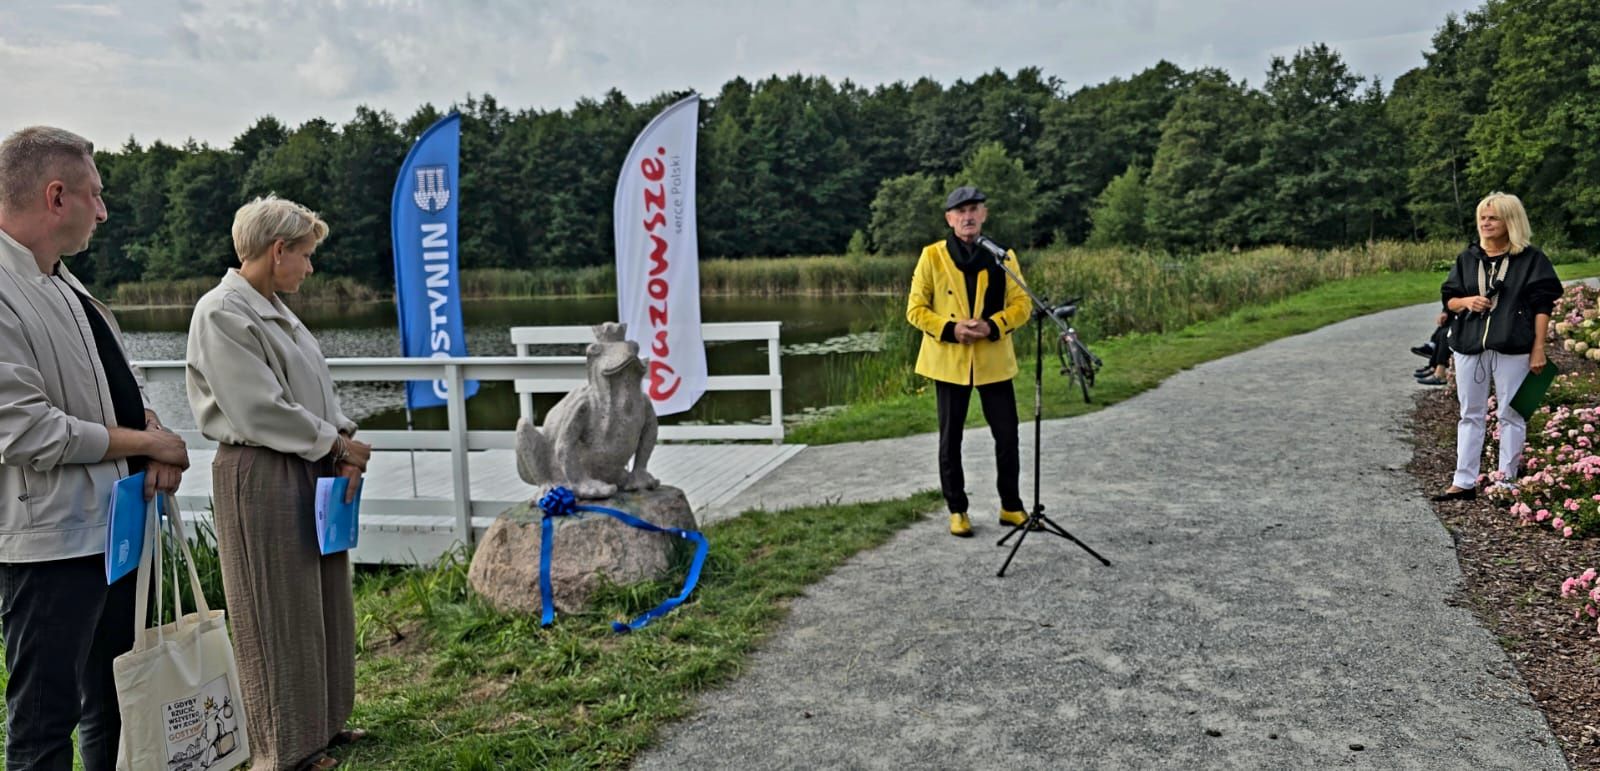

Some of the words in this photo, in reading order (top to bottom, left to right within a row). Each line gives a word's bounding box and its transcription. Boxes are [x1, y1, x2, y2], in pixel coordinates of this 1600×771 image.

[670, 155, 682, 195] Polski
[673, 199, 684, 235] serce
[420, 222, 451, 400] GSTYNIN
[174, 698, 197, 710] GDYBY
